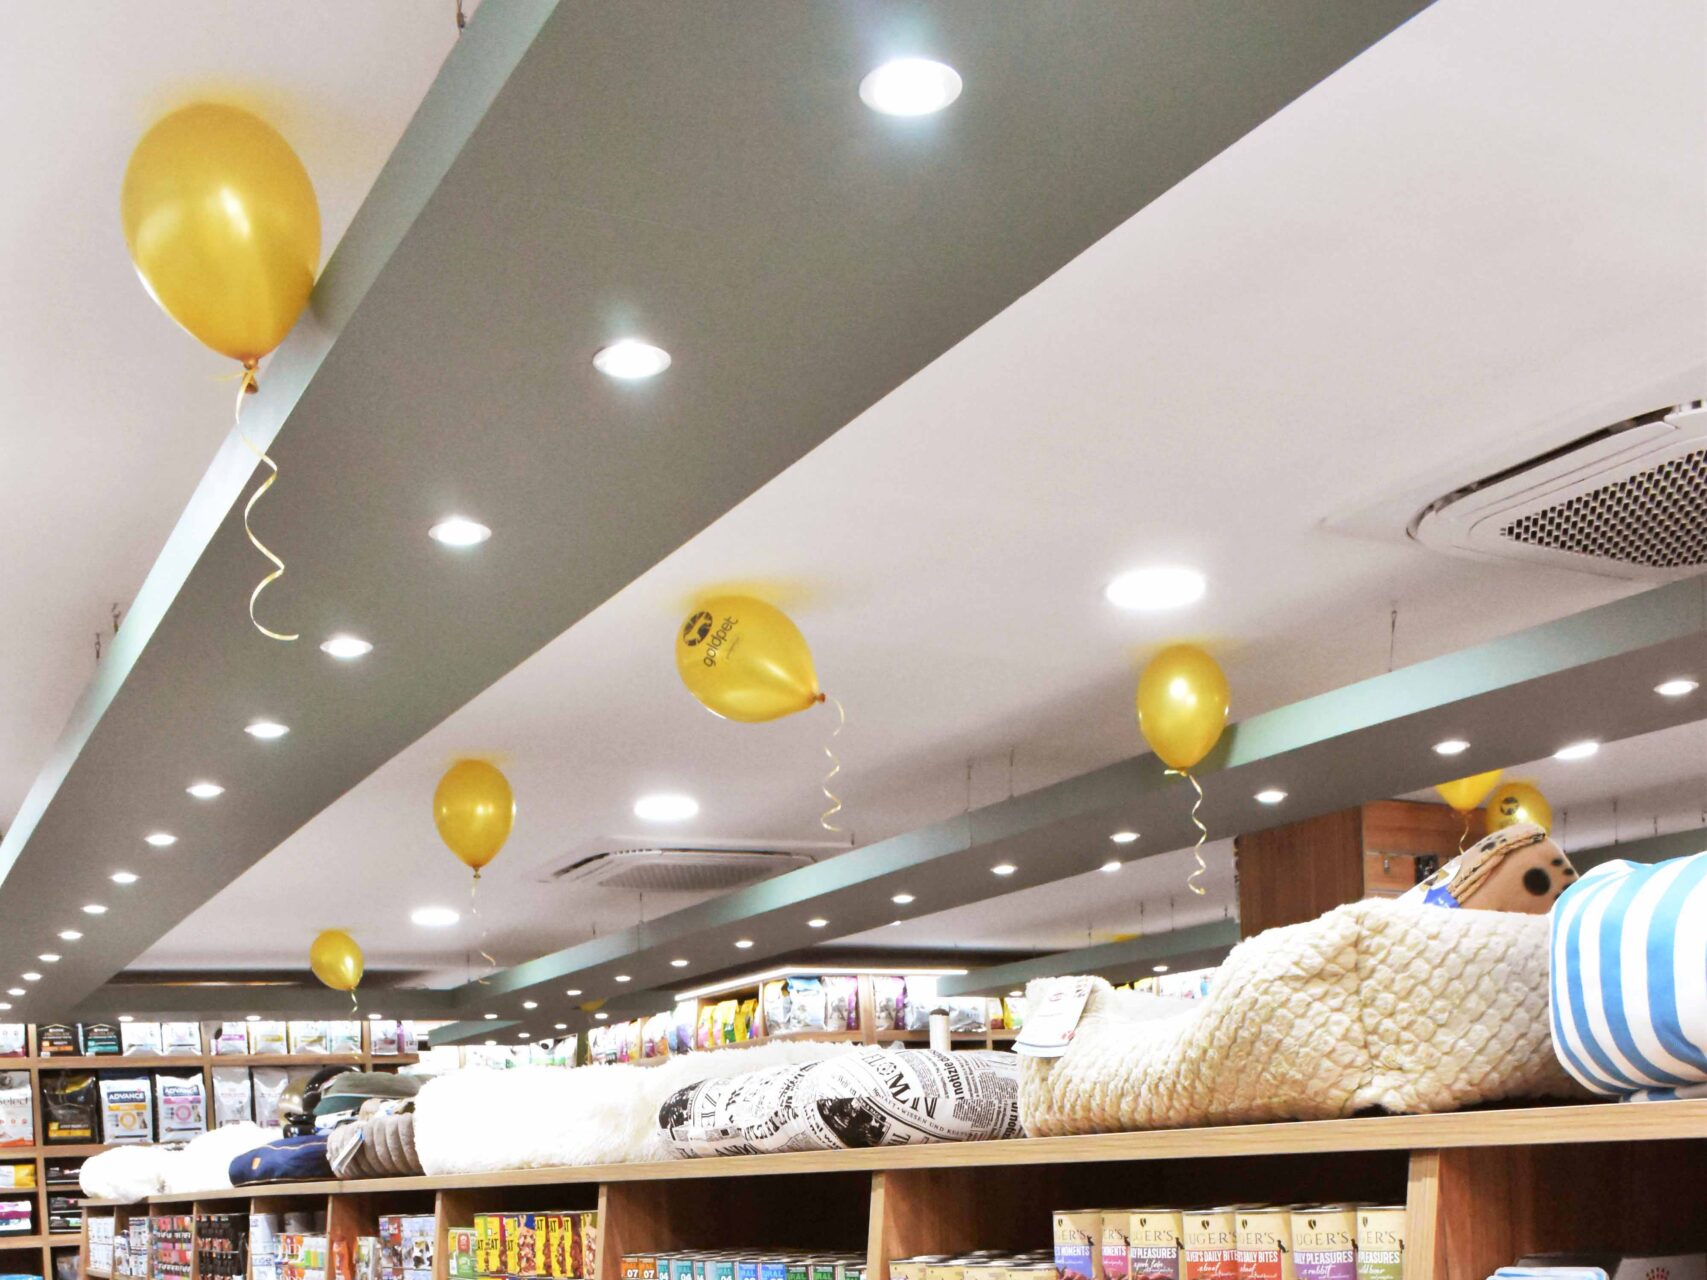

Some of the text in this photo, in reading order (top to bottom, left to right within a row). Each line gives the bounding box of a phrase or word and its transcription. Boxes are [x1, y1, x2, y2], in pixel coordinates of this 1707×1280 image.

[703, 615, 739, 668] goldpet
[109, 1092, 144, 1100] ADVANCE
[1138, 1247, 1177, 1259] PLEASURES
[1203, 1251, 1223, 1262] DAILY
[1258, 1251, 1278, 1263] BITES
[1307, 1252, 1354, 1265] PLEASURES
[627, 1269, 638, 1278] 07
[643, 1269, 654, 1279] 07
[659, 1273, 669, 1280] 04
